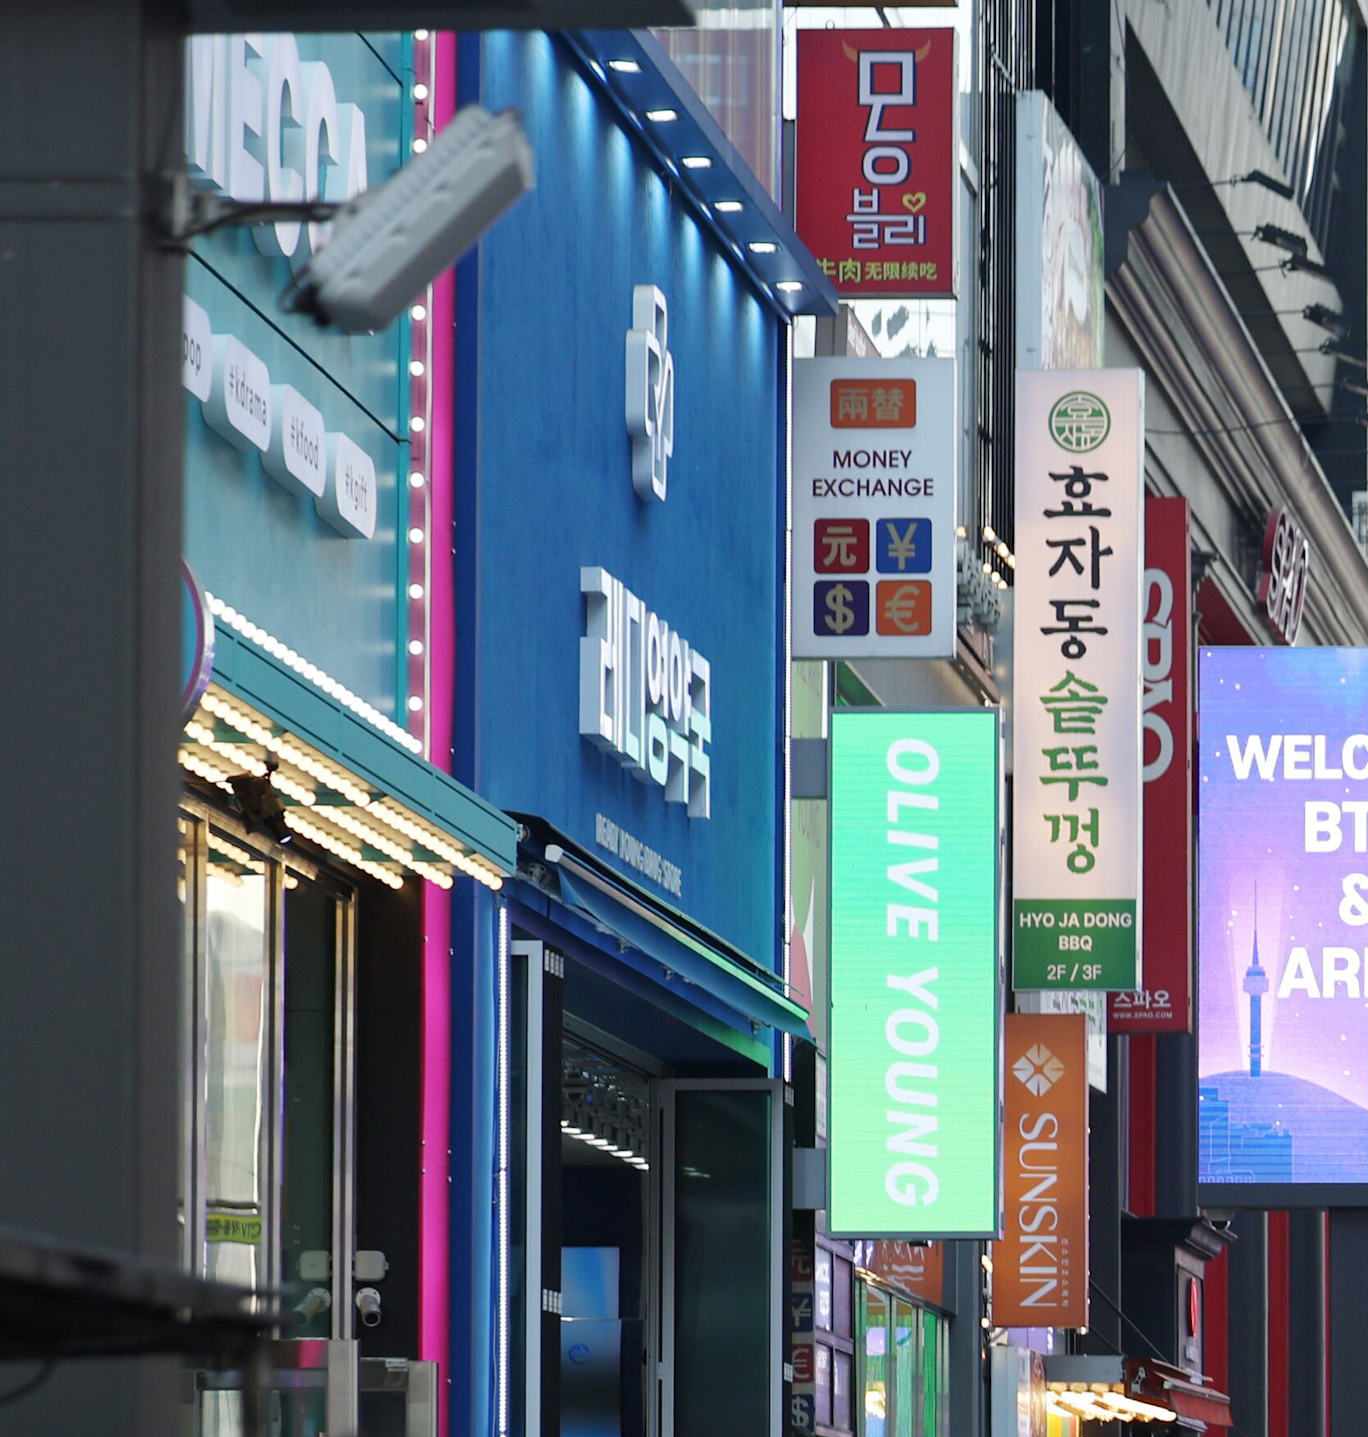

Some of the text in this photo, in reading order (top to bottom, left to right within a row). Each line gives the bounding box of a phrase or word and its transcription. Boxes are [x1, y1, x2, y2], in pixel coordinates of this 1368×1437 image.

[229, 363, 268, 427] #kdrama
[290, 415, 319, 471] #kfood
[832, 449, 912, 470] MONEY
[344, 463, 368, 512] #kgift
[811, 478, 934, 497] EXCHANGE
[821, 526, 858, 566] 元
[1018, 913, 1133, 929] HYO JA DONG
[1058, 936, 1093, 952] BBQ
[885, 737, 940, 1207] OLIVE YOUNG
[1046, 964, 1067, 980] 2F
[1082, 964, 1103, 980] 3F
[1113, 990, 1171, 1009] 스파오
[1018, 1112, 1058, 1308] SUNSKIN
